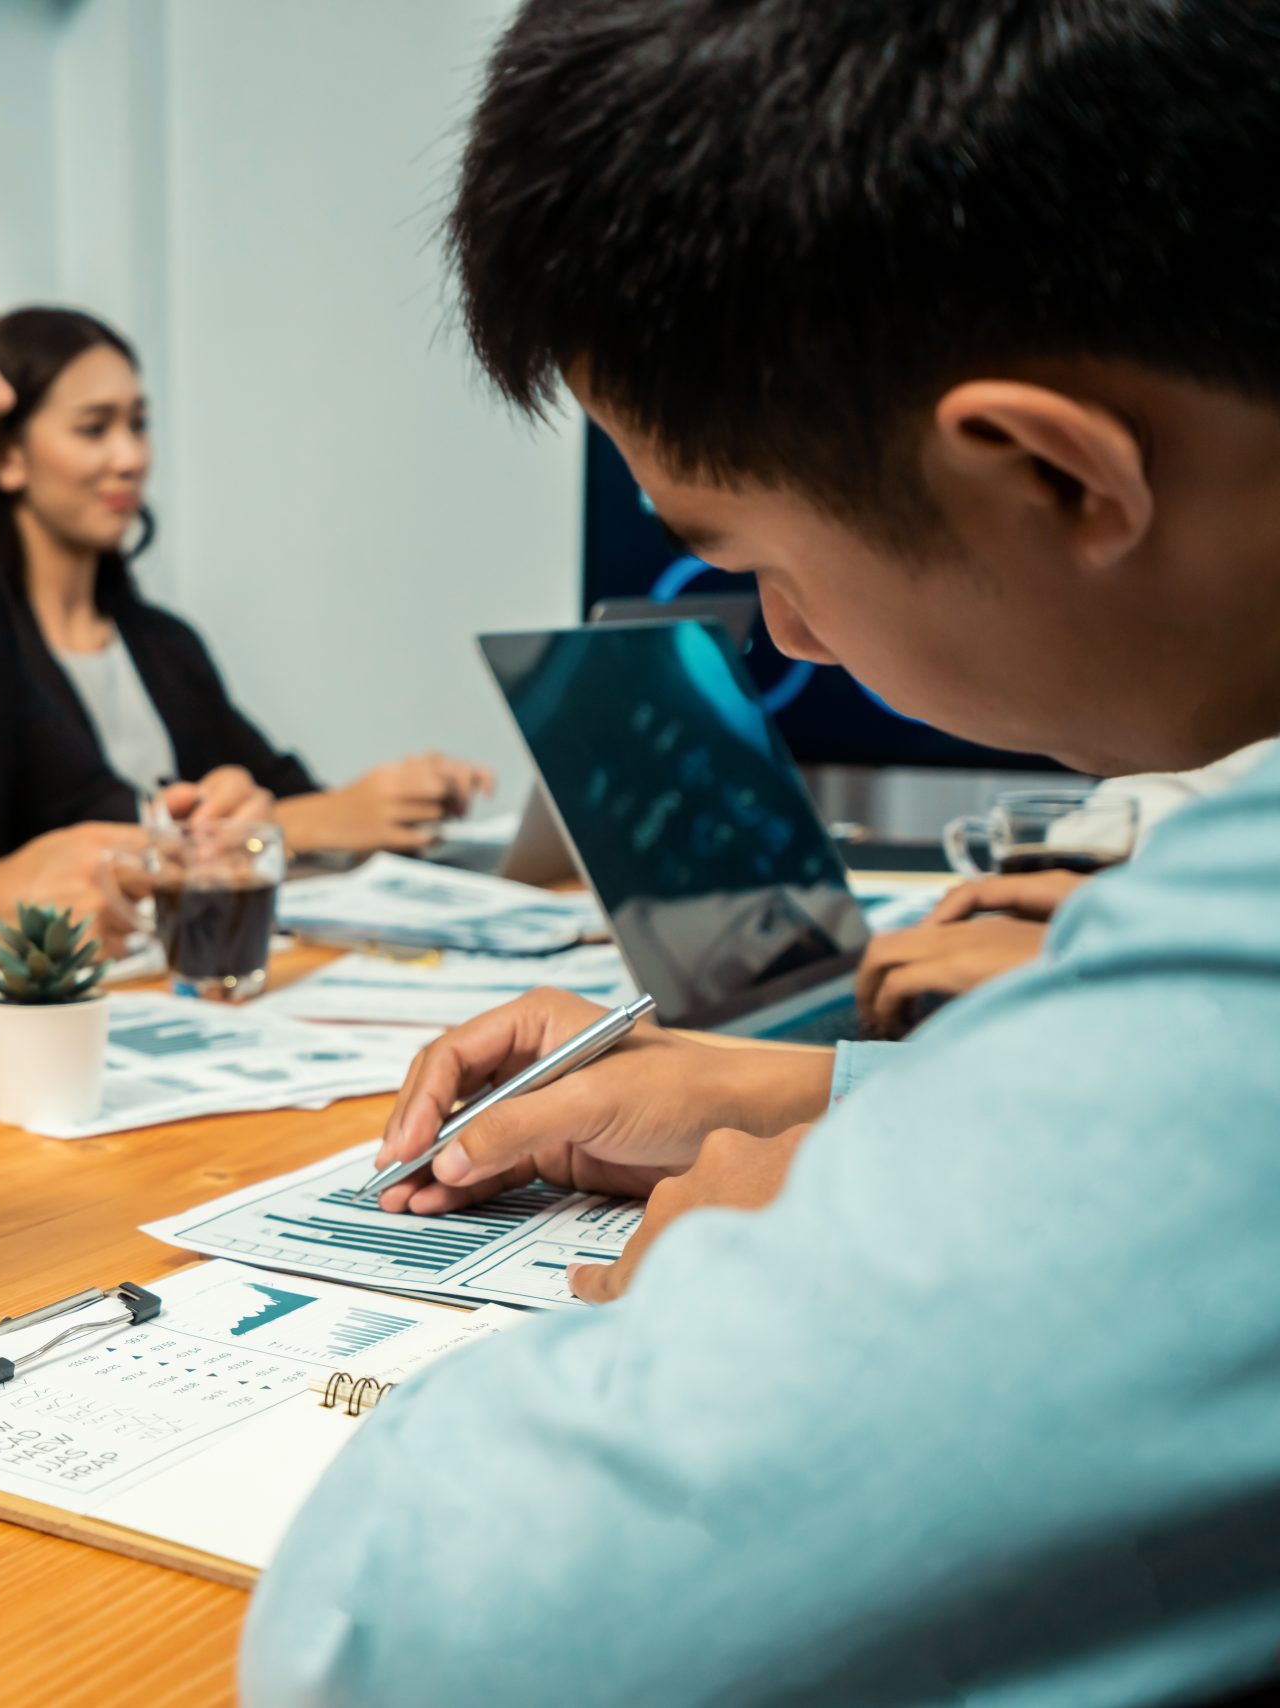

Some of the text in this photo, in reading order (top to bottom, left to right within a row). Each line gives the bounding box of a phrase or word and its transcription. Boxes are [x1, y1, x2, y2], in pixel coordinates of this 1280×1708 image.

[3, 1433, 74, 1465] HAEW
[35, 1448, 89, 1473] JJAS
[59, 1451, 119, 1481] RRAP
